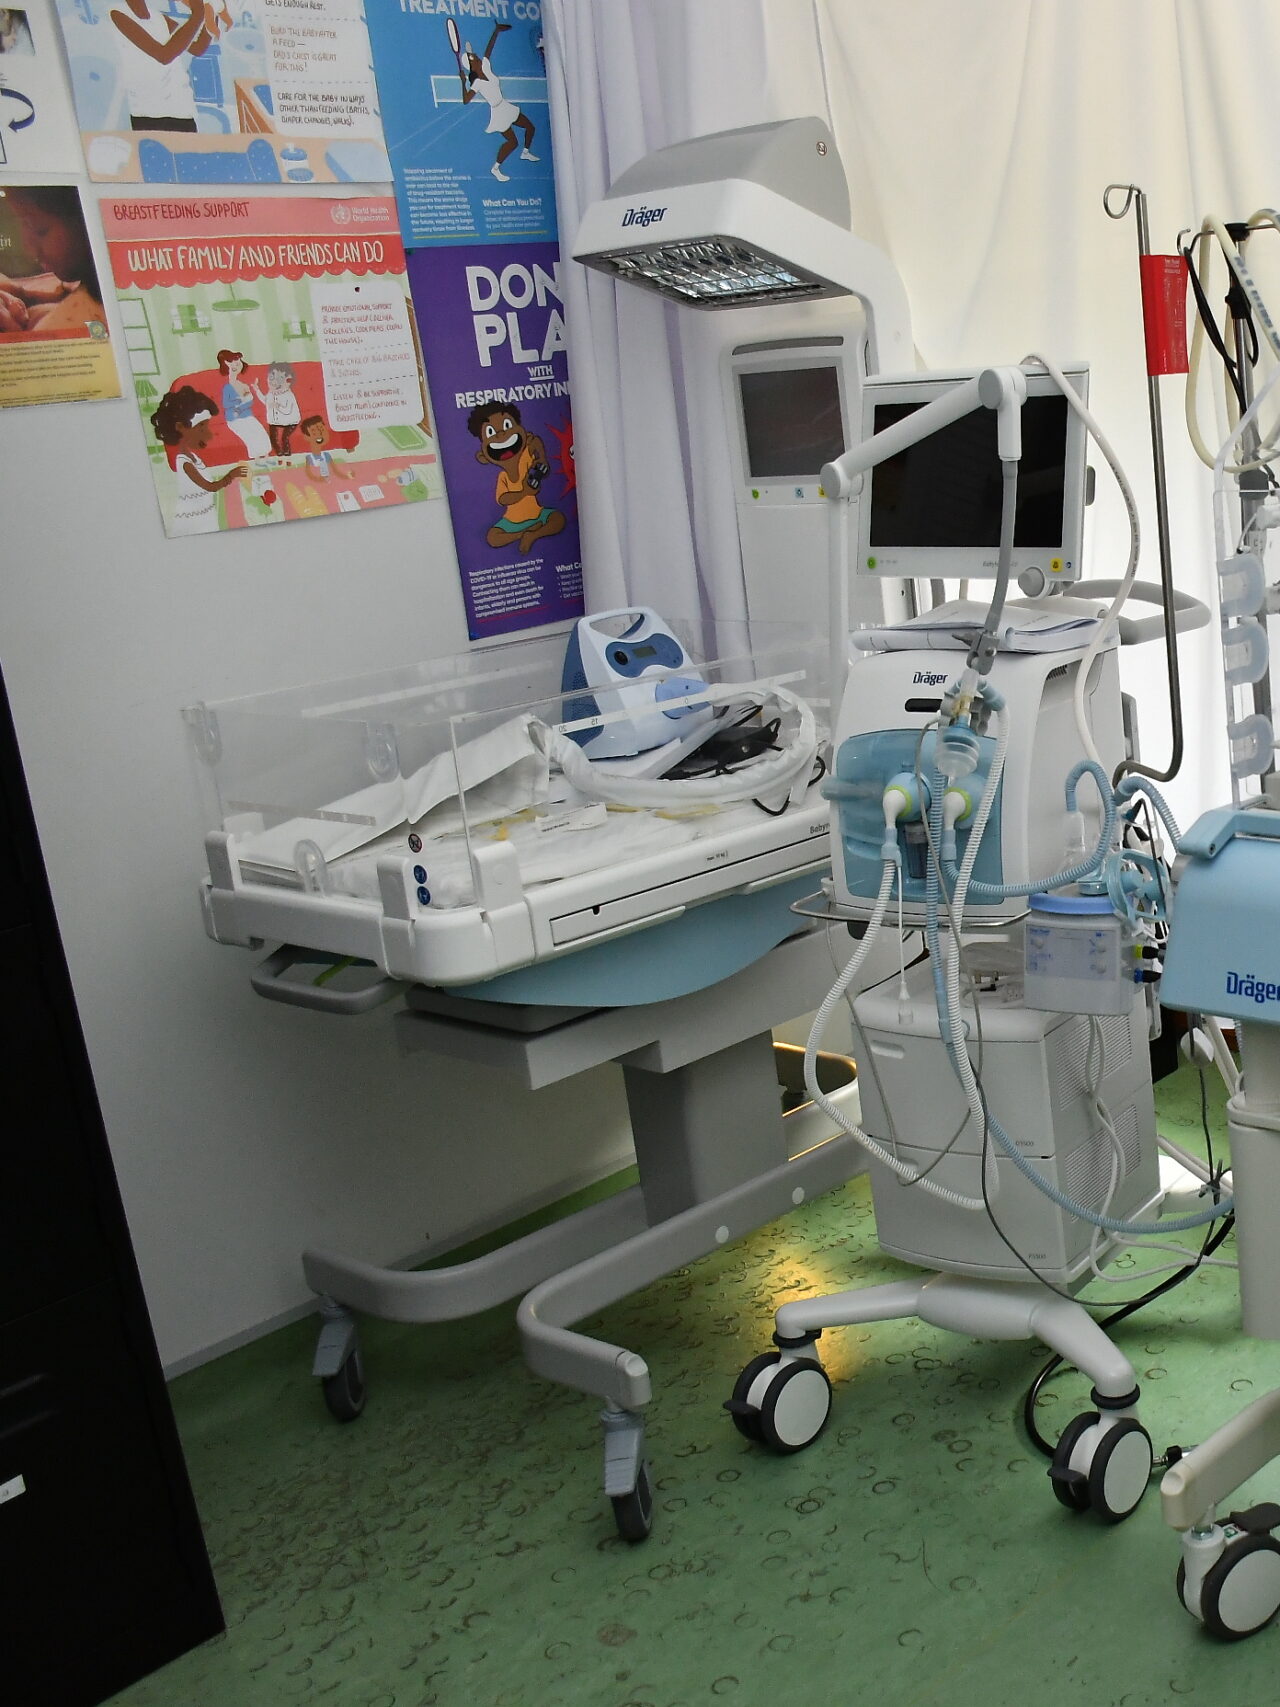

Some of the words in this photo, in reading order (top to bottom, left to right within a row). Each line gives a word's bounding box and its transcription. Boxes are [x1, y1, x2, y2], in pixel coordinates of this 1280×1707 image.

[400, 0, 509, 19] TREATMENT
[277, 92, 292, 101] CARE
[294, 93, 307, 101] FOR
[309, 94, 320, 102] THE
[349, 95, 365, 105] WAYS
[279, 104, 299, 112] OTHER
[300, 105, 318, 113] THAN
[319, 105, 345, 113] FEEDING
[281, 116, 303, 124] DIAPER
[482, 199, 501, 207] What
[516, 198, 529, 206] You
[530, 198, 542, 206] Do?
[113, 204, 201, 220] BREASTFEEDING
[203, 202, 250, 218] SUPPORT
[621, 206, 668, 227] Dräger
[352, 214, 390, 223] Organization
[127, 247, 173, 272] WHAT
[178, 244, 235, 271] FAMILY
[239, 244, 276, 268] AND
[279, 242, 333, 266] FRIENDS
[334, 241, 361, 265] CAN
[362, 240, 384, 263] DO
[528, 365, 553, 378] WITH
[455, 383, 553, 409] RESPIRATORY
[555, 564, 574, 573] What
[912, 671, 949, 686] Dräger
